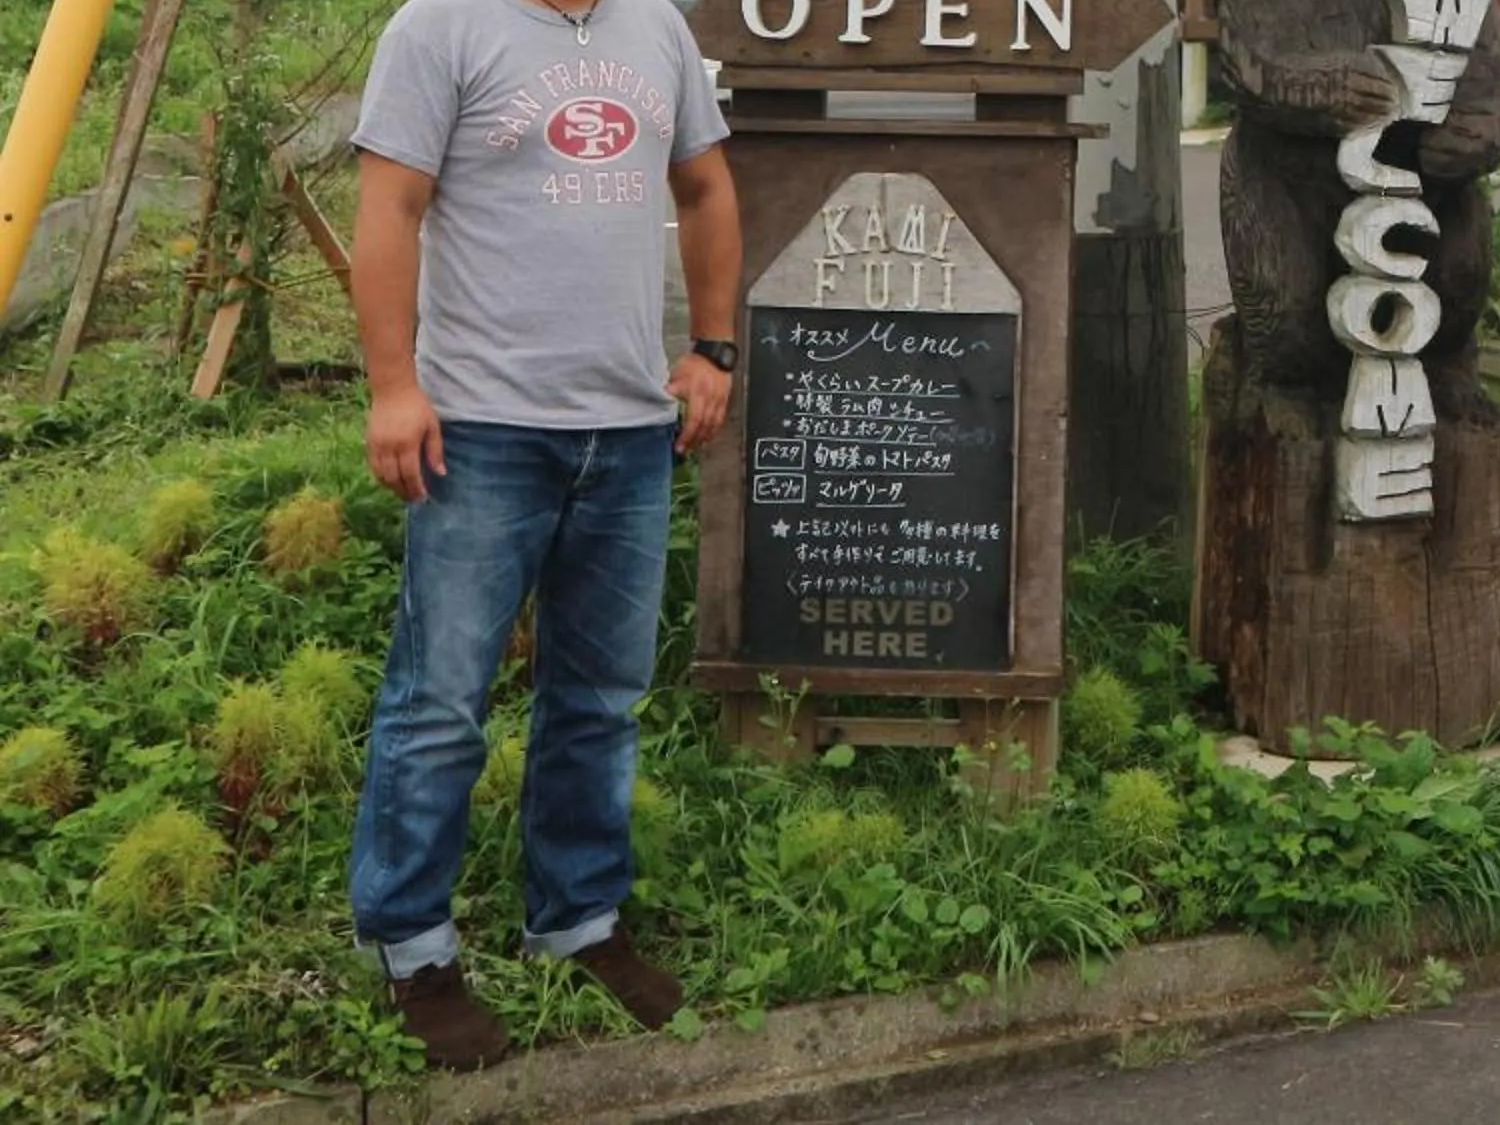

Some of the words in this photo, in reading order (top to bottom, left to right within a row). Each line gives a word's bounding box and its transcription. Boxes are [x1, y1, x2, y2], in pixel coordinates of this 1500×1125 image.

[485, 89, 543, 150] SAN
[539, 59, 671, 139] FRANCISCO
[822, 204, 955, 259] KAMI
[812, 258, 956, 310] FUJI
[789, 323, 849, 347] オススメ
[800, 598, 953, 626] SERVED
[823, 631, 928, 658] HERE
